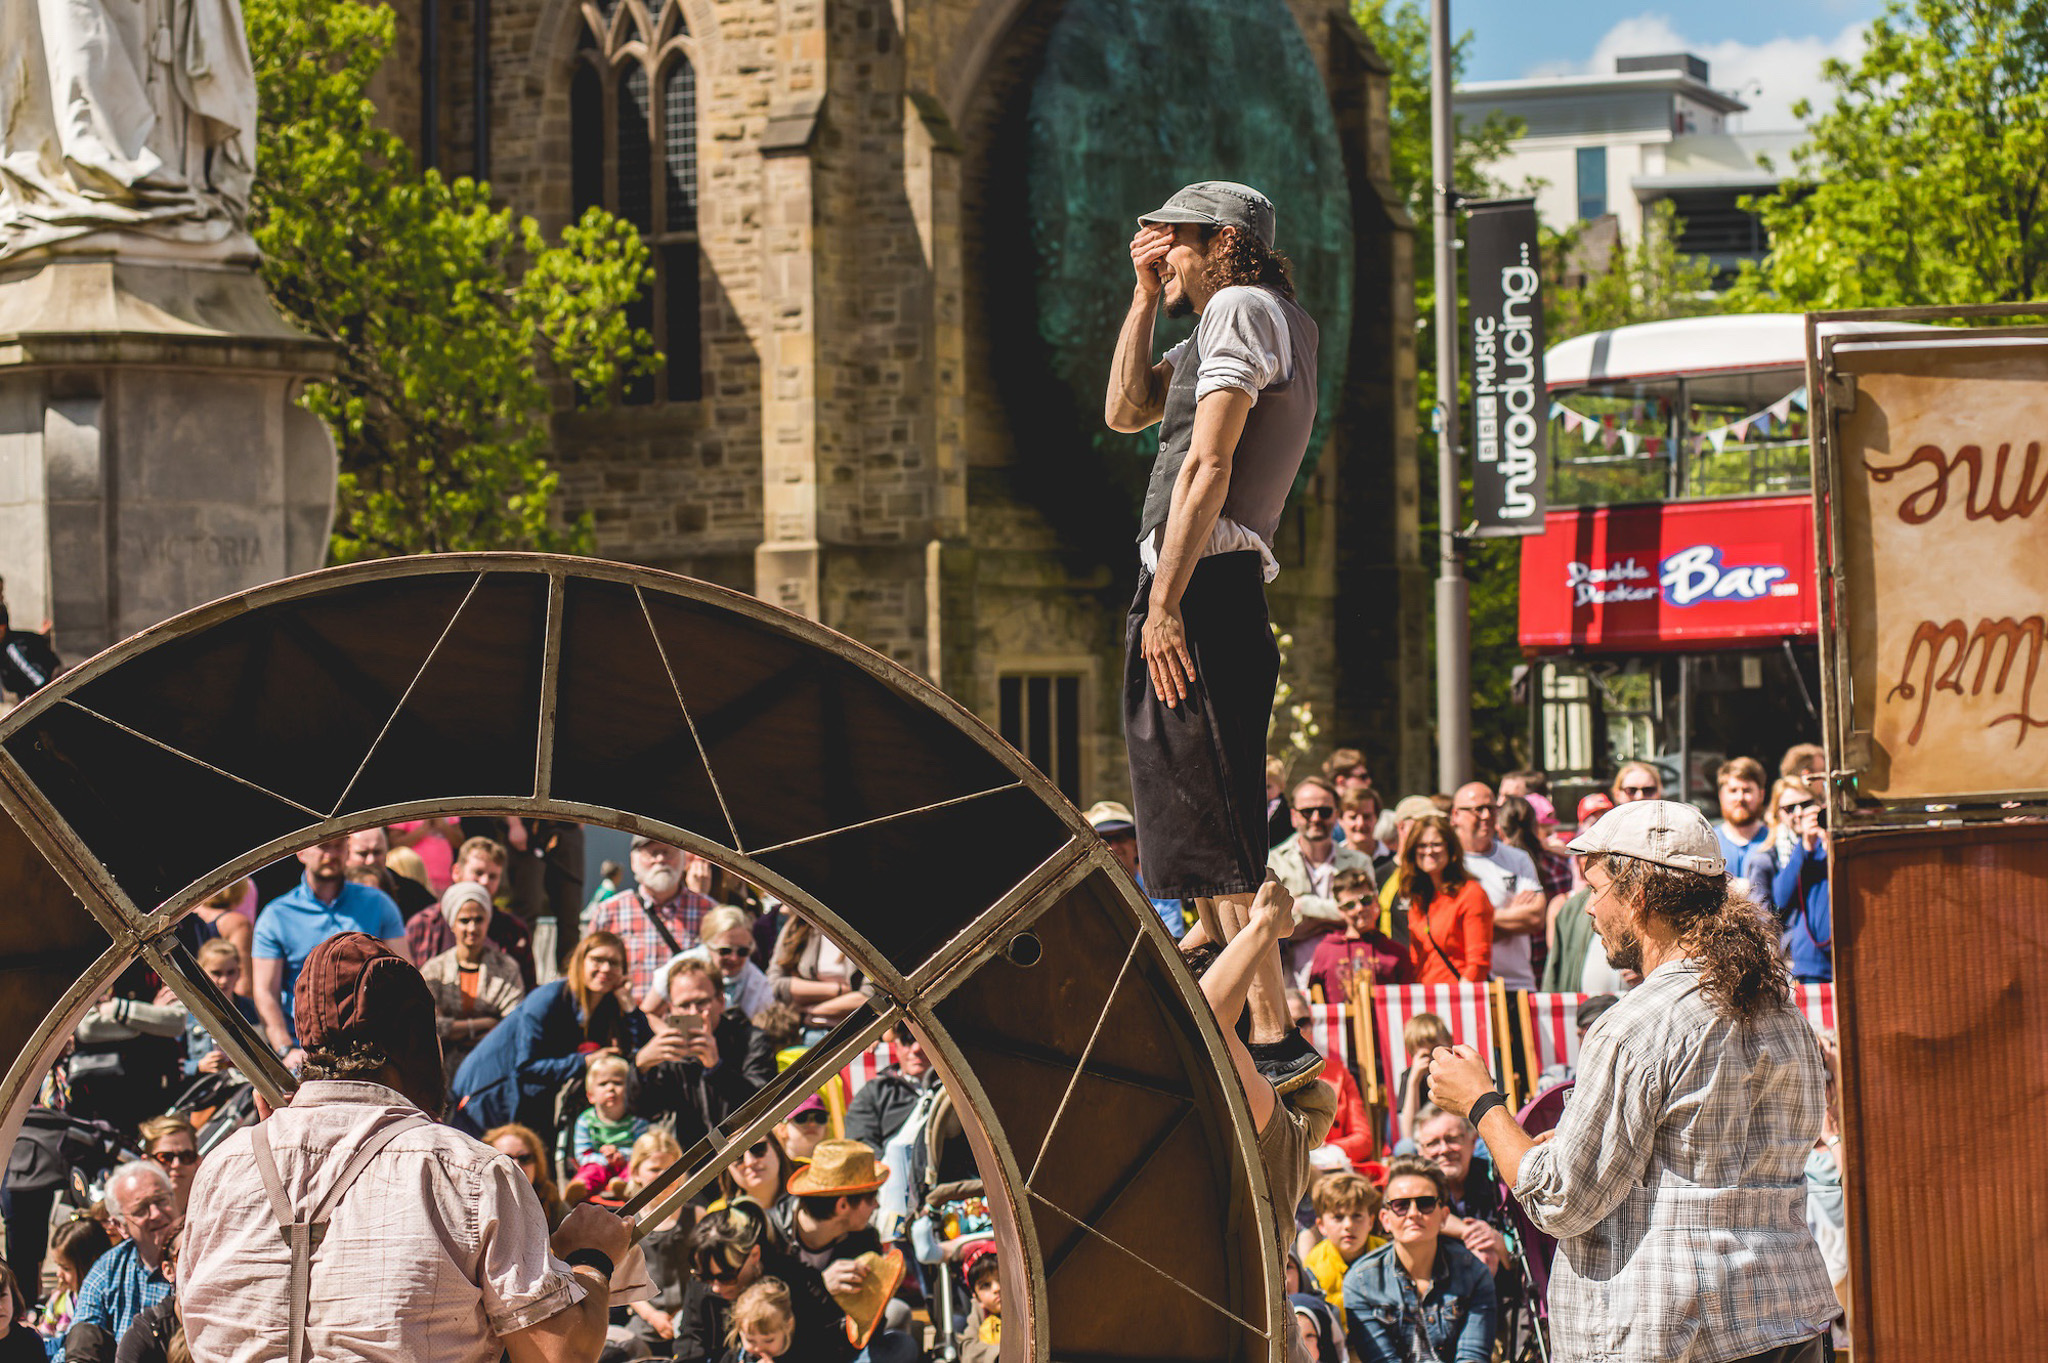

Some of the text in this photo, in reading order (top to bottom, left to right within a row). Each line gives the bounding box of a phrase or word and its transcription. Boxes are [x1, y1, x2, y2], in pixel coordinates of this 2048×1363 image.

[1475, 316, 1498, 462] BBC MUSIC
[1497, 242, 1539, 519] introducing...
[139, 535, 267, 567] VICTORIA
[1566, 557, 1649, 587] Double
[1659, 545, 1785, 604] Bar
[1886, 615, 2048, 750] turb
